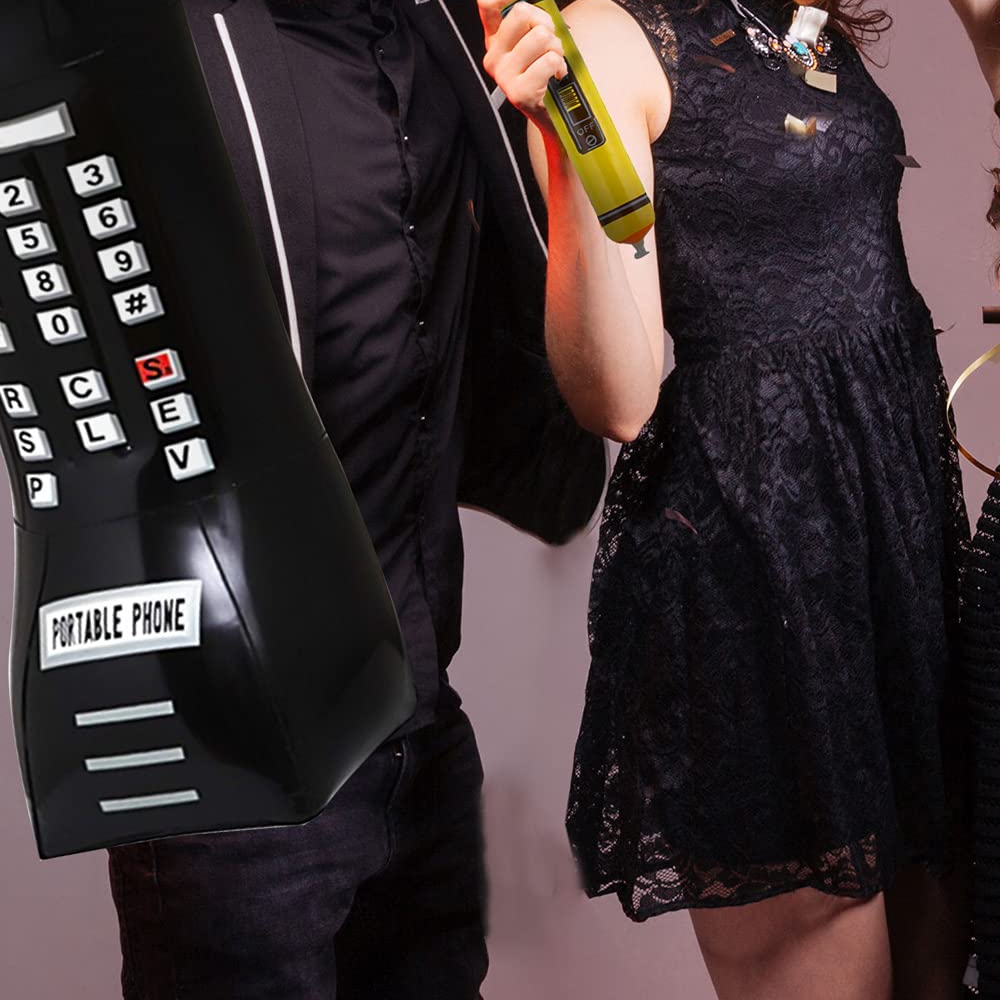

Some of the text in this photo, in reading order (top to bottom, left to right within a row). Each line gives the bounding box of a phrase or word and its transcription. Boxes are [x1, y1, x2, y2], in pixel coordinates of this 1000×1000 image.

[576, 121, 595, 136] OFF
[83, 164, 104, 186] 3
[3, 185, 25, 206] 2
[98, 206, 118, 228] 6
[21, 228, 39, 249] 5
[115, 250, 133, 272] 9
[36, 270, 55, 292] 8
[124, 292, 148, 315] #
[51, 313, 69, 335] 0
[69, 376, 93, 398] C
[3, 388, 23, 409] R
[158, 399, 181, 423] E
[18, 431, 36, 453] S
[83, 421, 105, 442] L
[168, 445, 190, 469] V
[30, 477, 43, 499] P
[52, 597, 186, 650] PORTABLE PHONE
